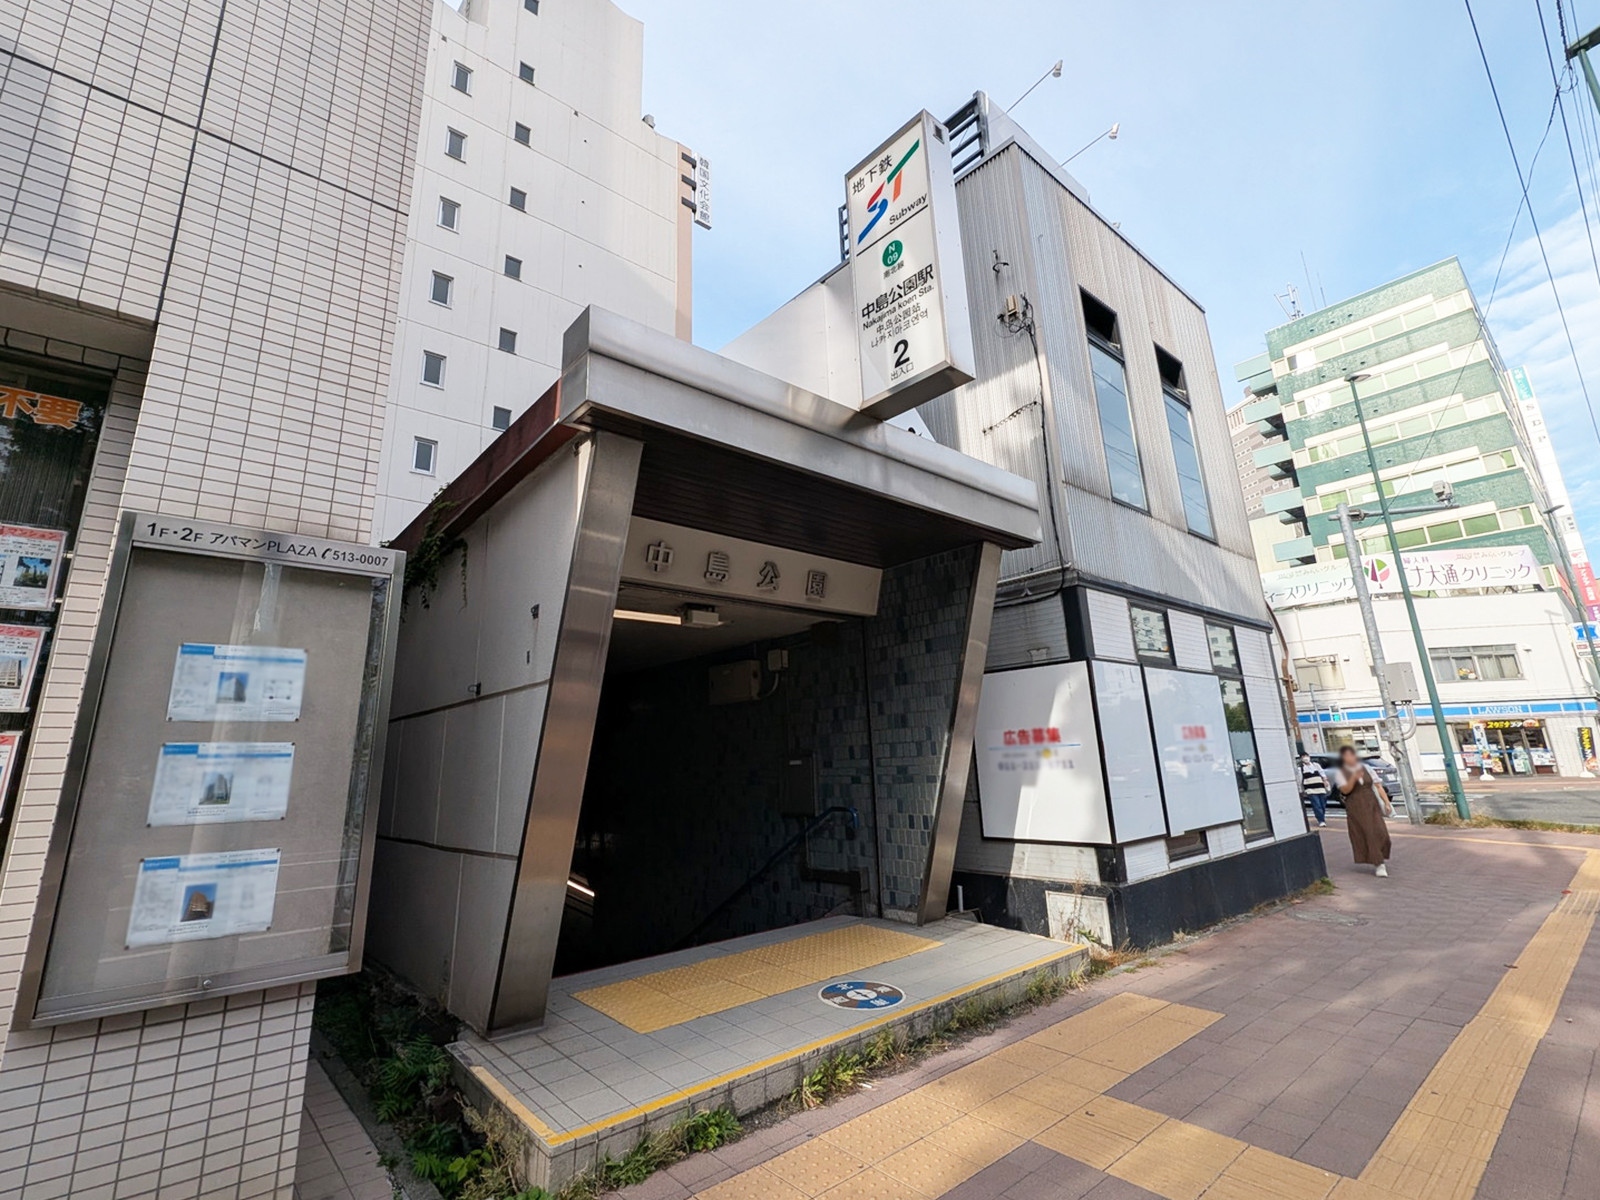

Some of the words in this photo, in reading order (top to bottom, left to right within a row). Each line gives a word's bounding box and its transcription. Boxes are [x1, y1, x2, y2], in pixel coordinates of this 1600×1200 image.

[852, 155, 893, 195] 地下鉄
[889, 193, 928, 225] Subway
[887, 252, 898, 264] 09
[888, 243, 896, 254] N
[861, 264, 934, 319] 中島公園駅
[862, 306, 897, 331] Nakajima
[918, 284, 935, 297] Sta.
[893, 339, 910, 369] 2
[890, 361, 915, 381] 出入口
[0, 385, 83, 430] 不要
[332, 551, 389, 568] 513-0007
[645, 541, 828, 599] 中島公園
[1264, 576, 1355, 603] ィースクリニック
[1477, 705, 1523, 715] LAWSON
